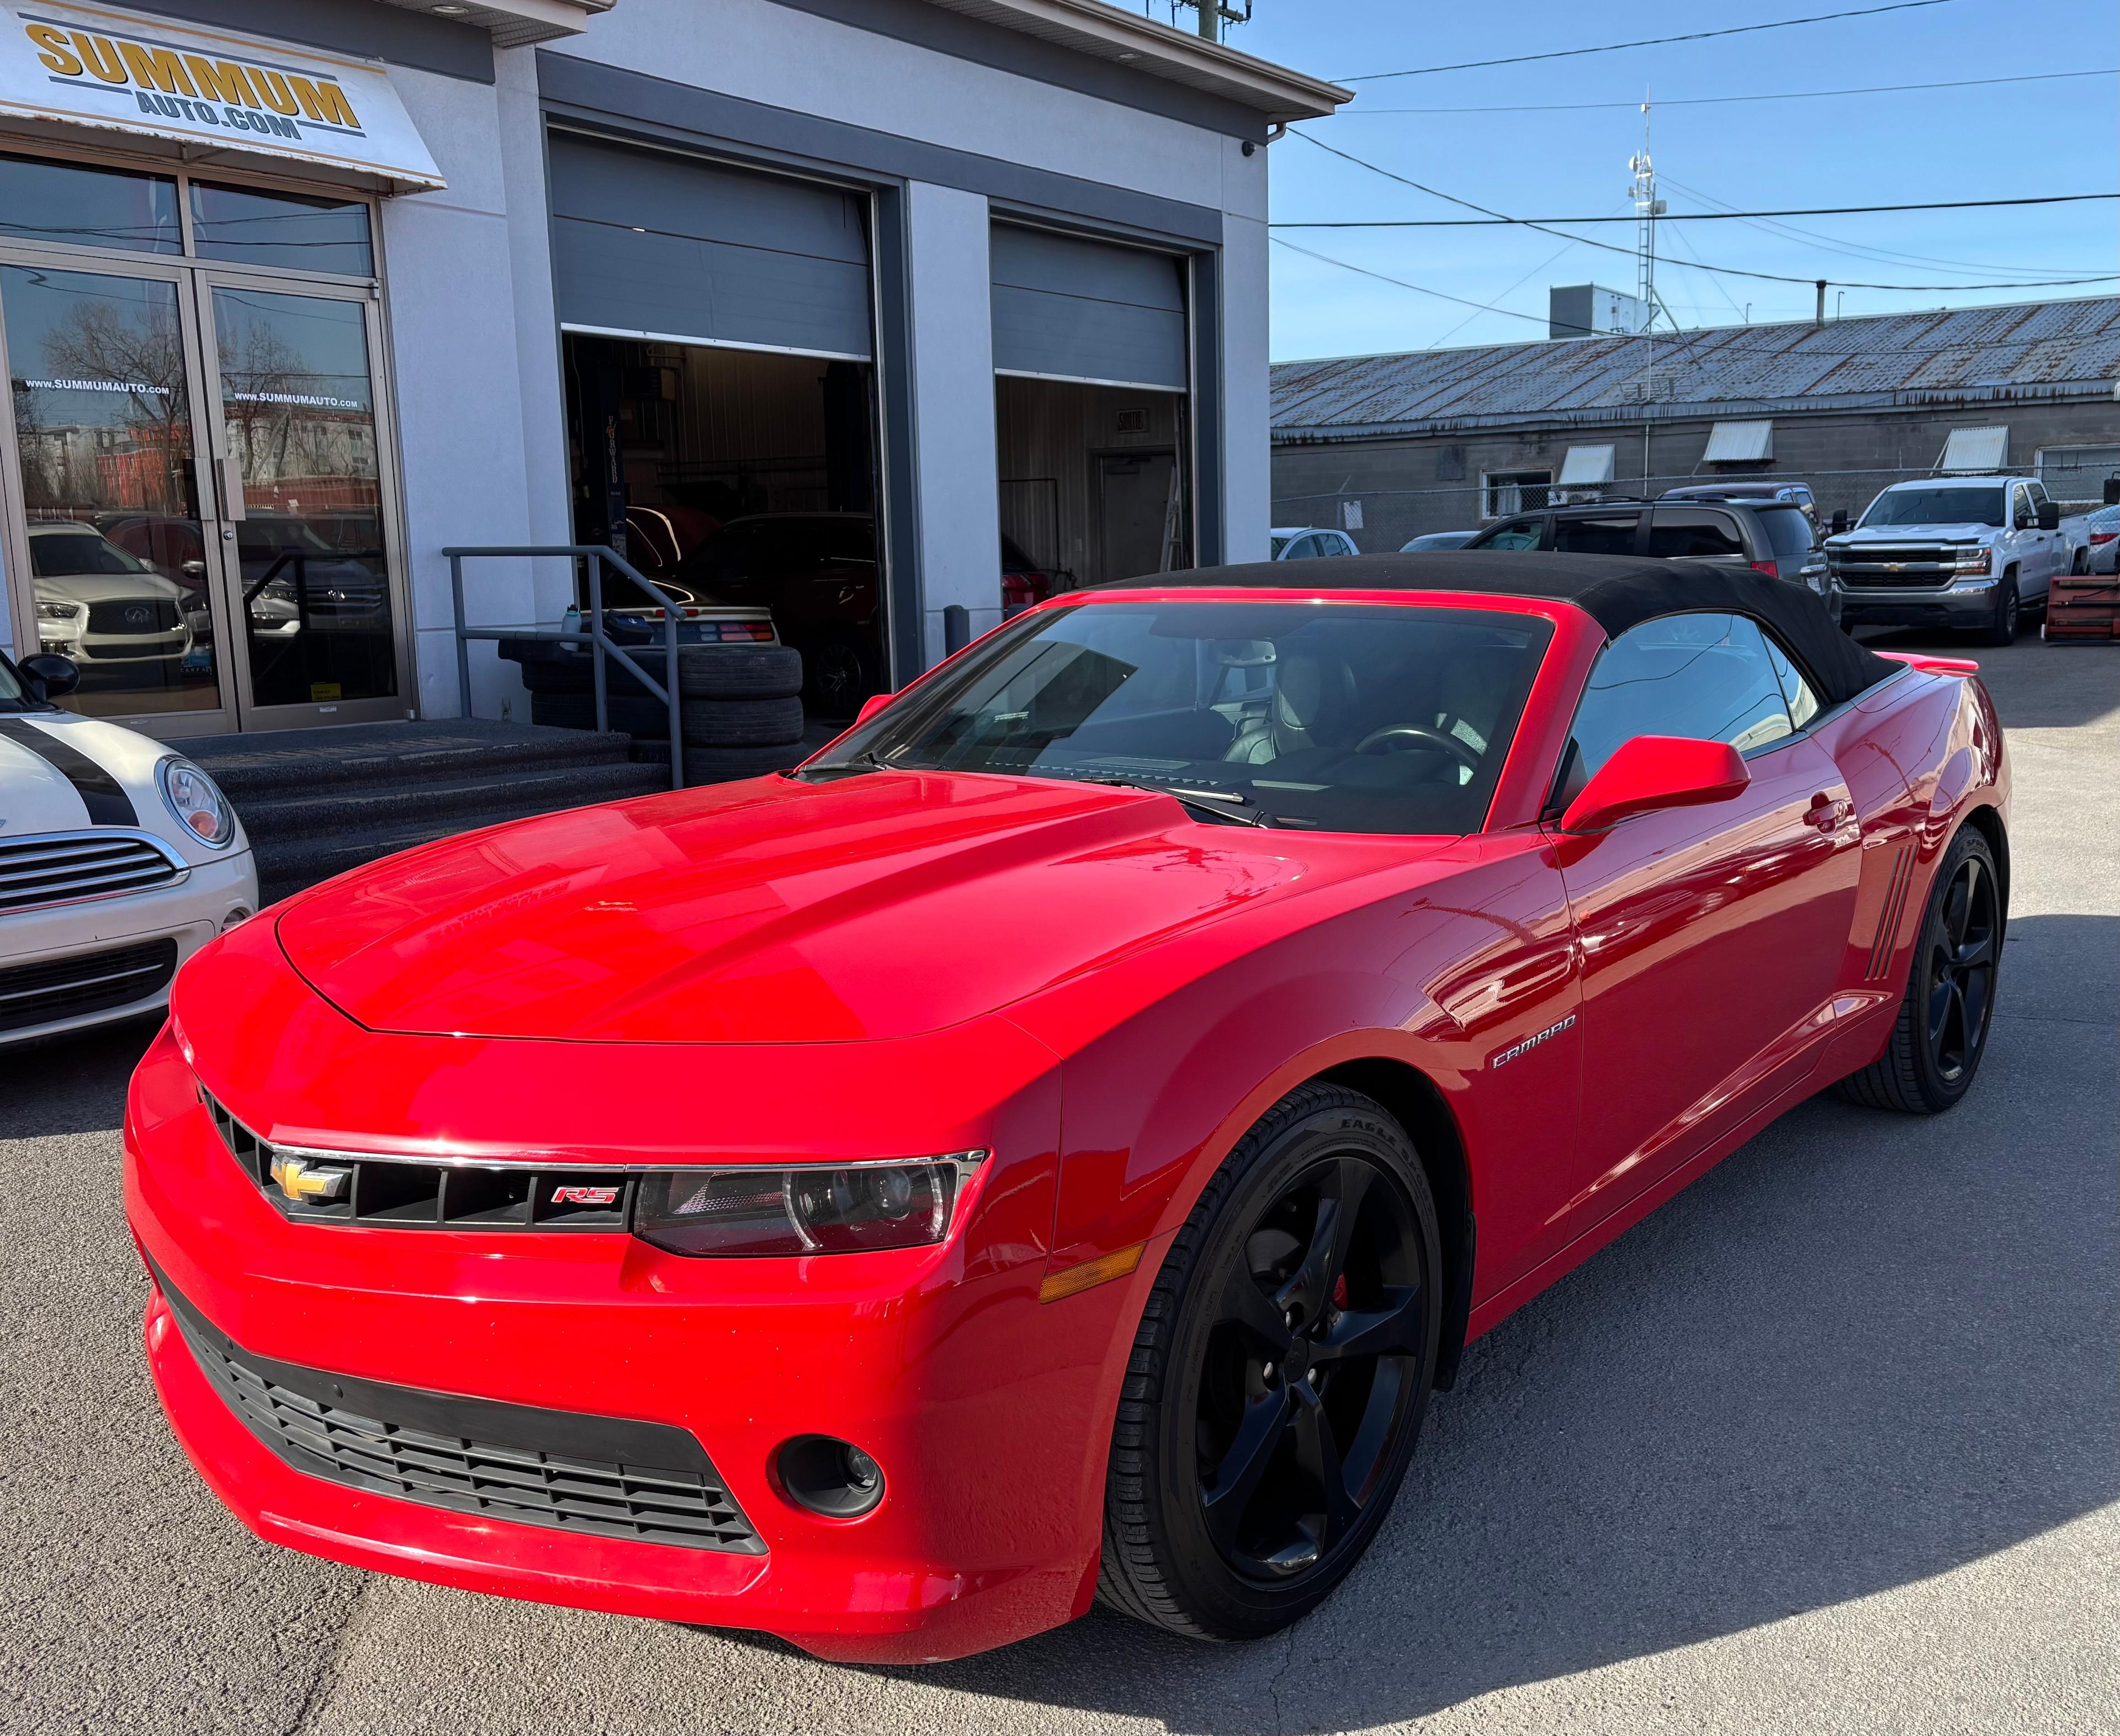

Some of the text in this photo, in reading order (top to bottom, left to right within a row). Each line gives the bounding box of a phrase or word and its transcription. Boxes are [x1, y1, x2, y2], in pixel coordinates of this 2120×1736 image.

[25, 24, 362, 128] SUMMUM
[137, 91, 302, 140] AUTO.COM
[1493, 1015, 1576, 1068] CAMARO
[1339, 1118, 1397, 1147] EAGLE
[551, 1187, 619, 1204] RS
